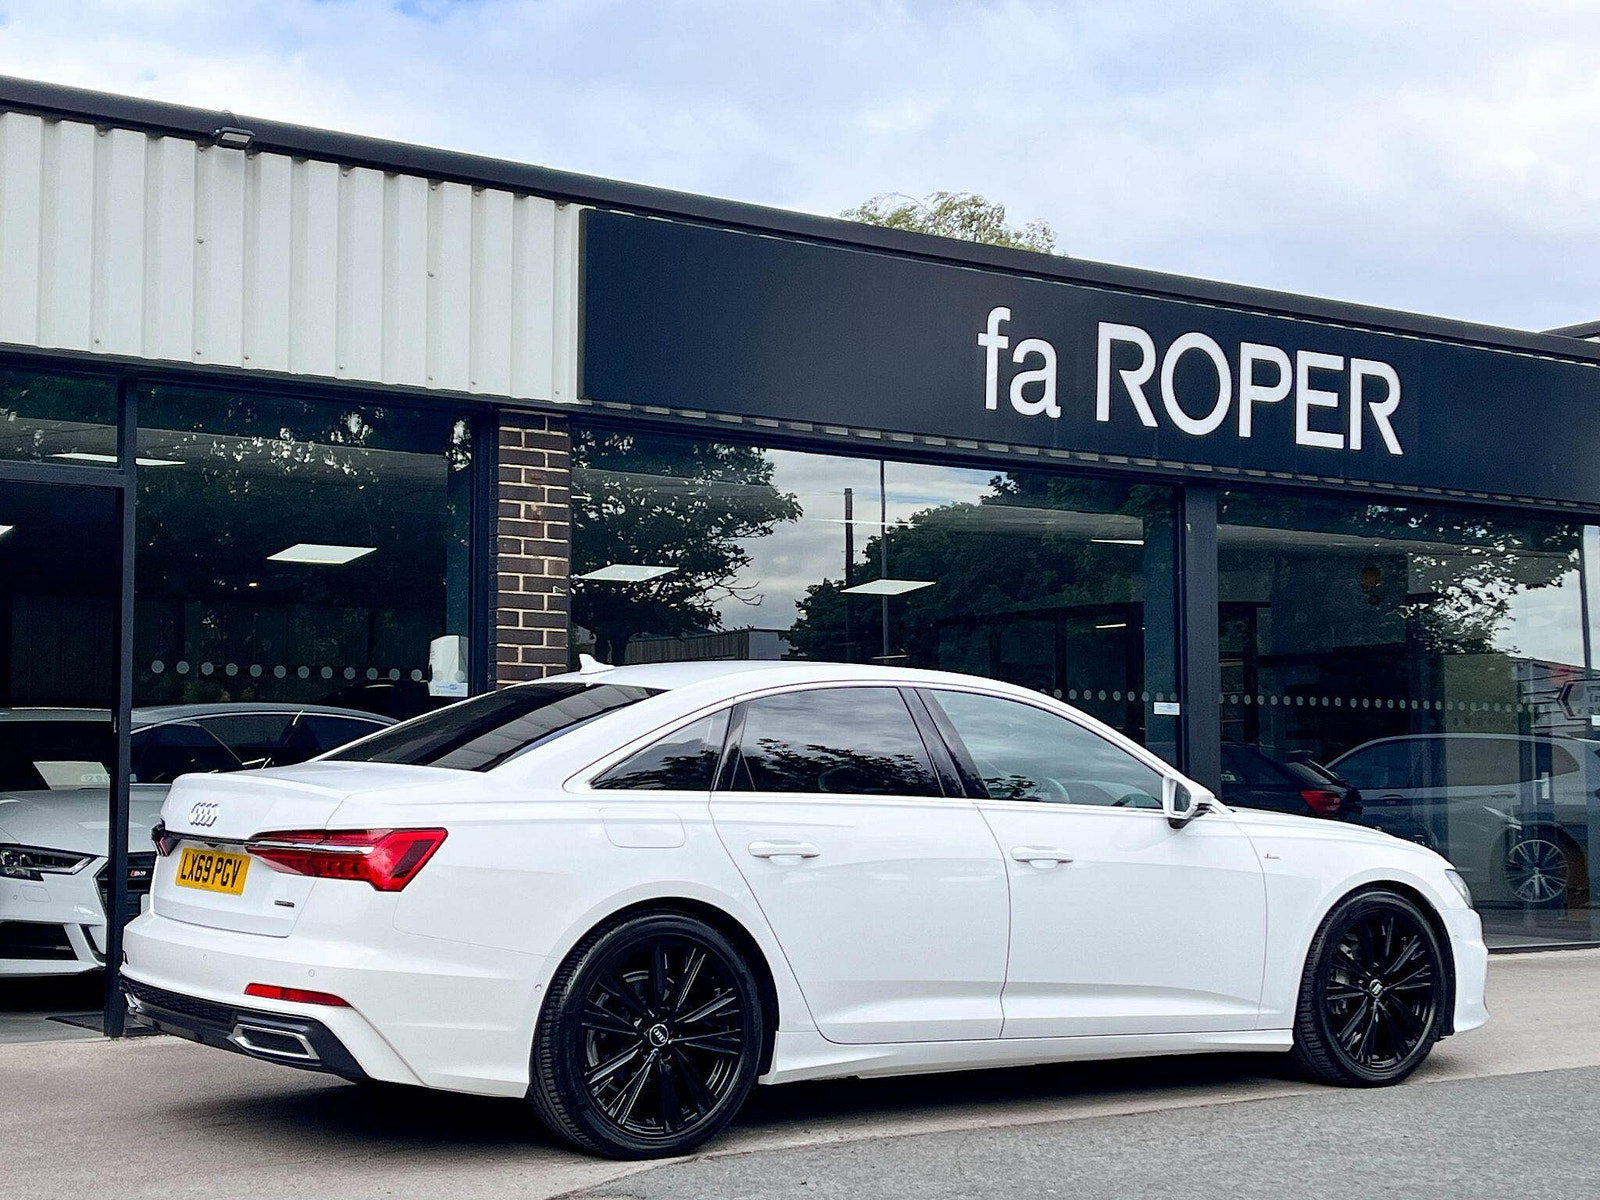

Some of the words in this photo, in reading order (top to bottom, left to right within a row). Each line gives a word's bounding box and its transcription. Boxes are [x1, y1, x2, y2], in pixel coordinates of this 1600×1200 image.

[977, 306, 1061, 418] fa
[1096, 321, 1403, 455] ROPER
[181, 852, 213, 883] LX69
[211, 857, 242, 888] PGV
